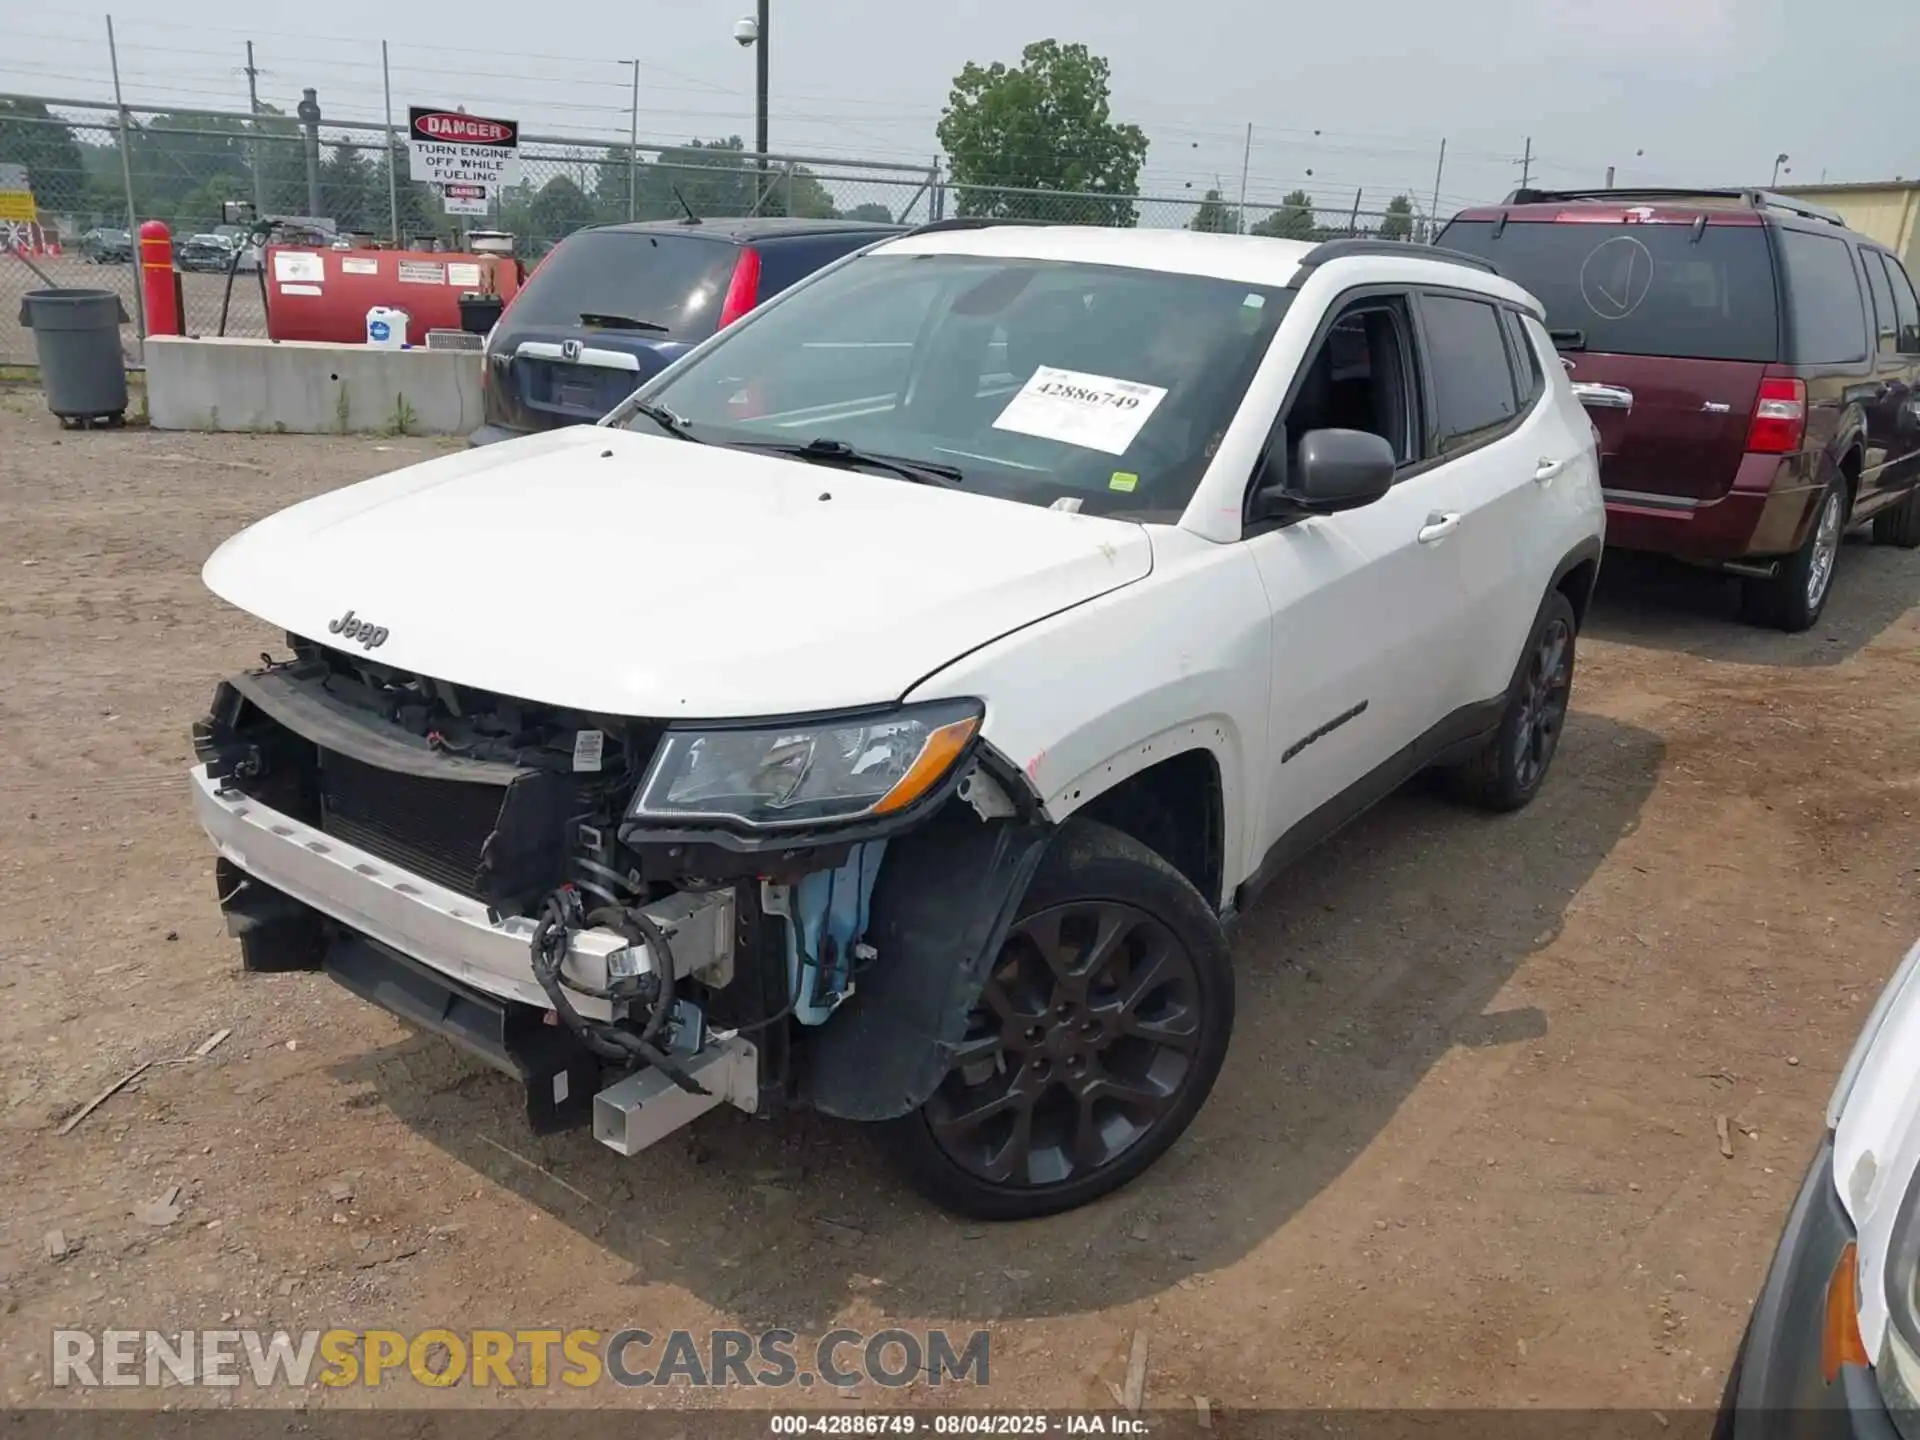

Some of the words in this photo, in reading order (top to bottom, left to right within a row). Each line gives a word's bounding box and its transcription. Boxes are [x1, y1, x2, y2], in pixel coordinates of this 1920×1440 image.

[427, 117, 501, 137] DANGER
[416, 144, 456, 155] TURN
[461, 147, 512, 159] ENGINE
[425, 156, 454, 166] OFF
[460, 159, 504, 170] WHILE
[434, 169, 497, 181] FUELING
[1037, 383, 1140, 408] 42886749
[328, 610, 389, 651] Jeep
